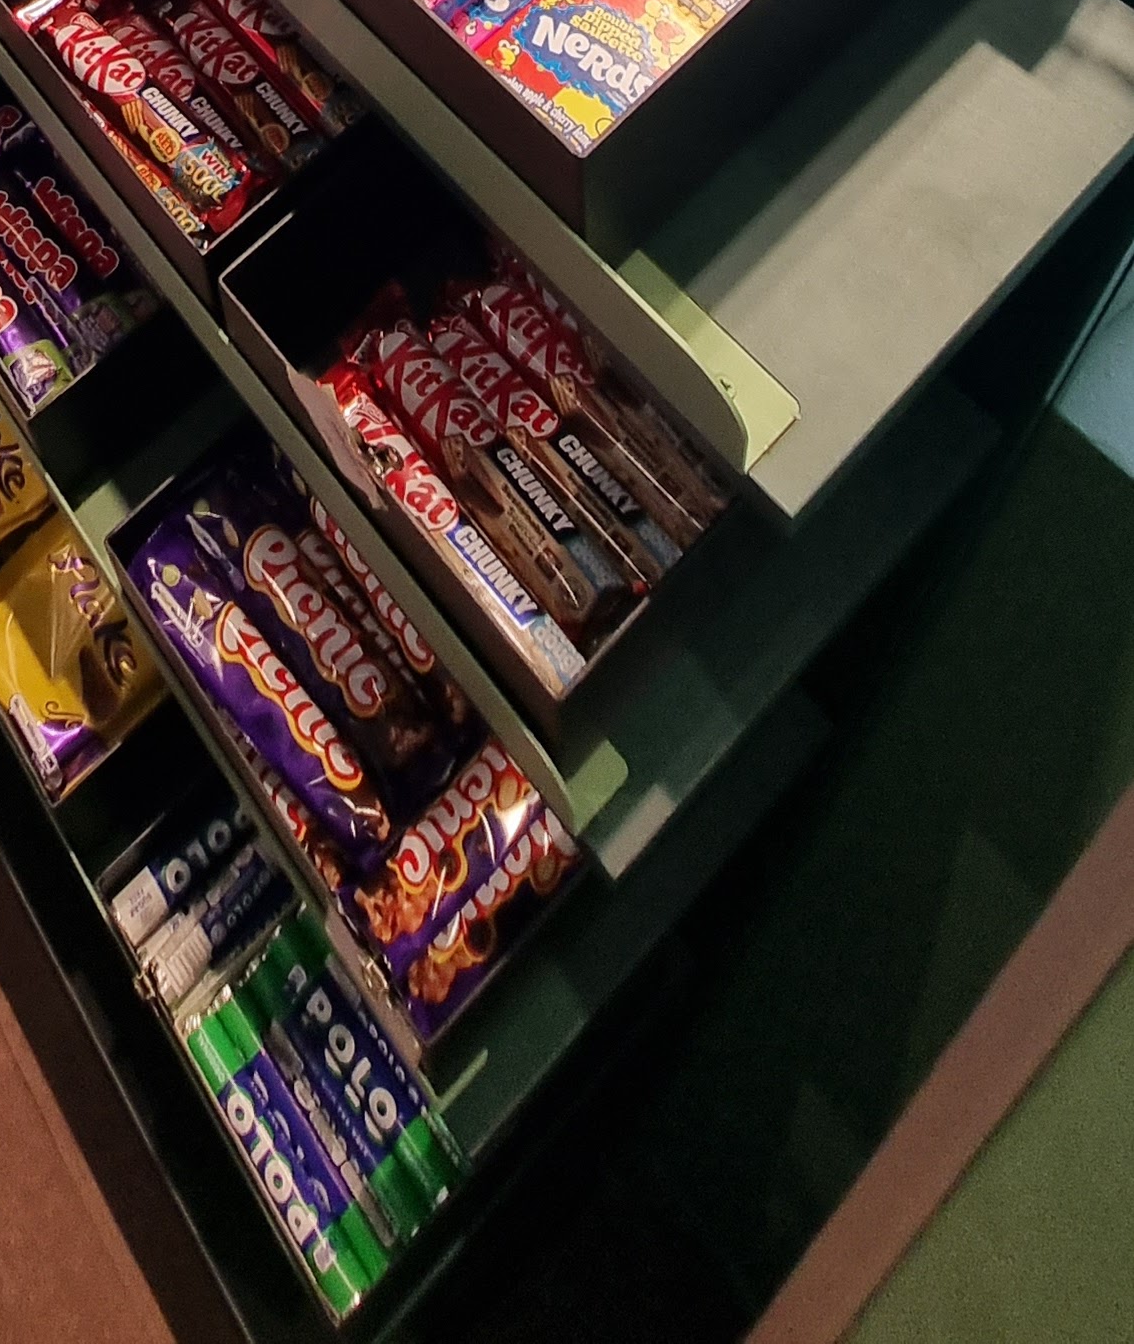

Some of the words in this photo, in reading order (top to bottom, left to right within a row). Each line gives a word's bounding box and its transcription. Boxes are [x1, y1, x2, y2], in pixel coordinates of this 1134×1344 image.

[61, 25, 146, 94] KitKat
[177, 12, 260, 84] KitKat
[141, 86, 200, 139] CHUNKY
[189, 95, 244, 151] CHUNKY
[255, 81, 309, 136] CHUNKY
[381, 336, 499, 447] KitKat
[436, 332, 560, 440] KitKat
[496, 447, 576, 533] CHUNKY
[558, 434, 640, 512] CHUNKY
[455, 524, 538, 615] CHUNKY
[306, 986, 398, 1144] POLO
[225, 1092, 321, 1247] POLO
